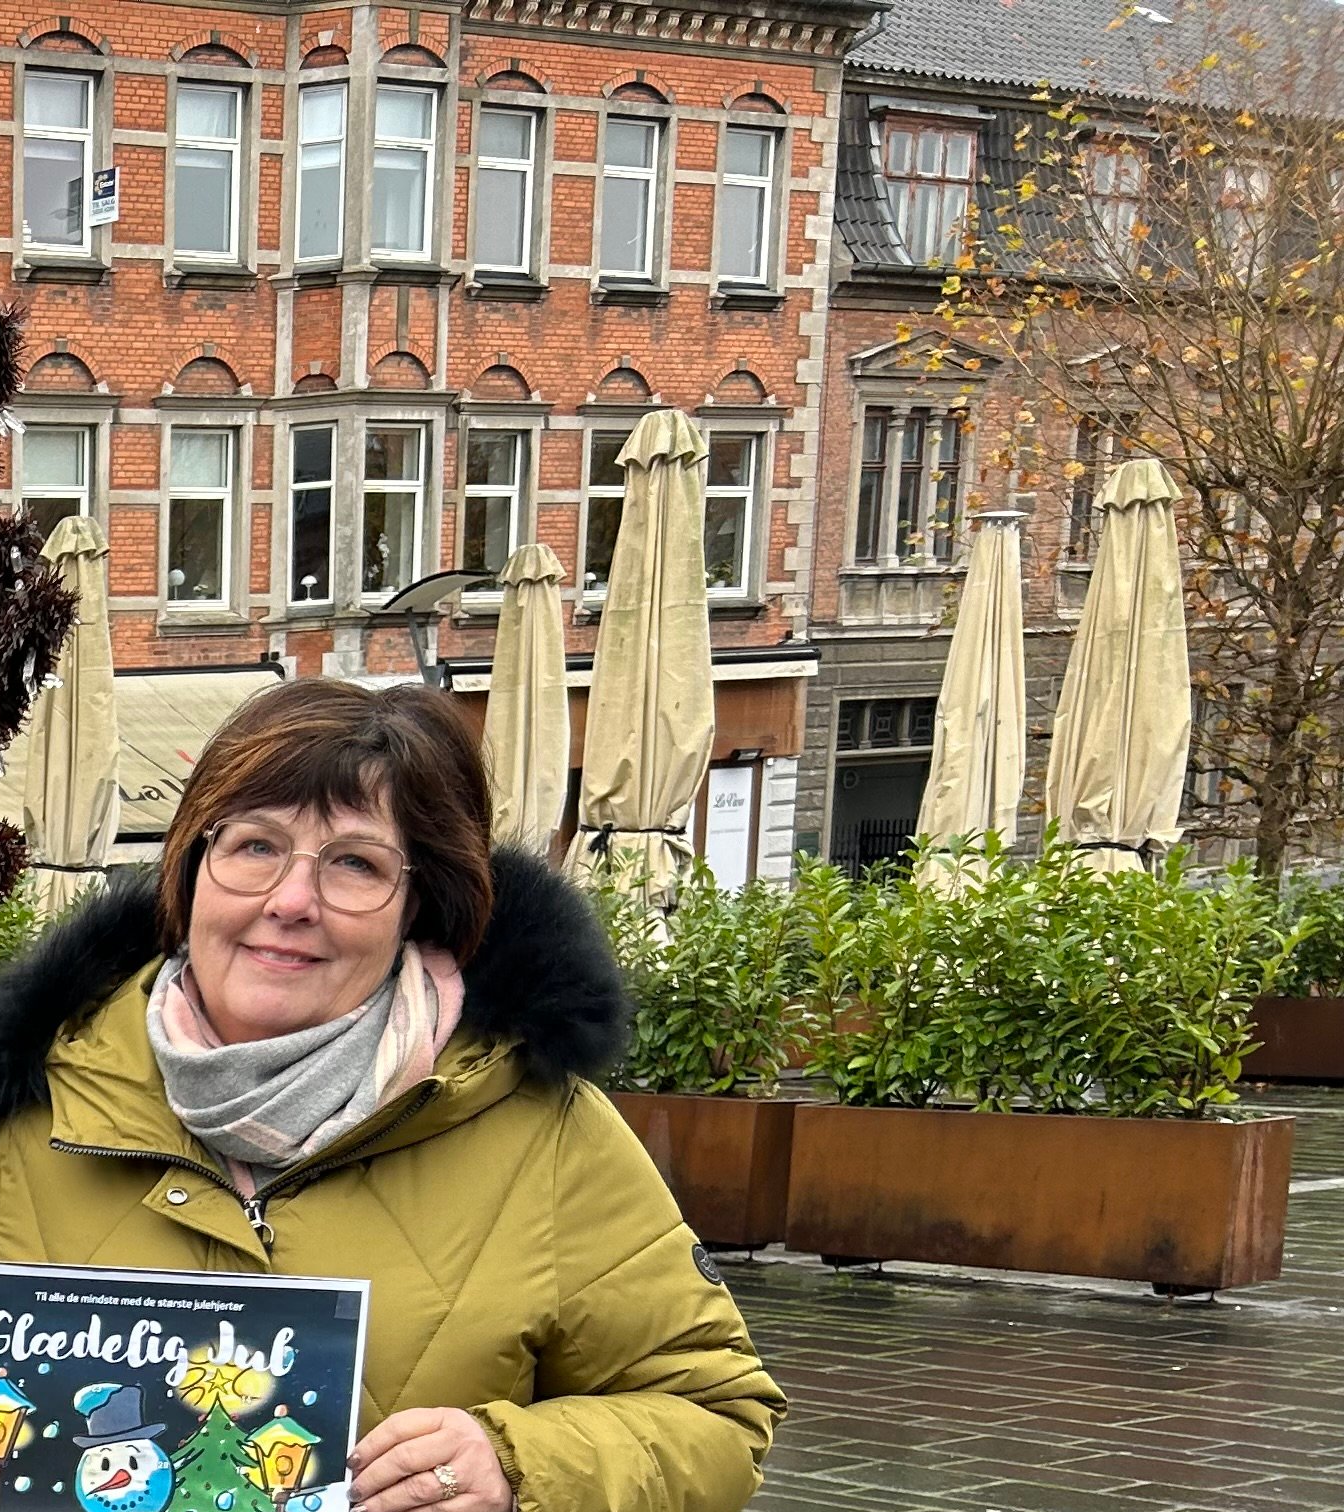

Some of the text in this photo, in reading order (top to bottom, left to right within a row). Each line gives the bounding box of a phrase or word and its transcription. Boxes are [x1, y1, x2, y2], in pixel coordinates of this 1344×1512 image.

[34, 1290, 48, 1302] Til
[66, 1292, 79, 1303] de
[80, 1293, 119, 1306] mindste
[120, 1295, 142, 1307] med
[142, 1296, 157, 1308] de
[192, 1298, 245, 1314] julehjerter
[206, 1320, 293, 1377] Jul
